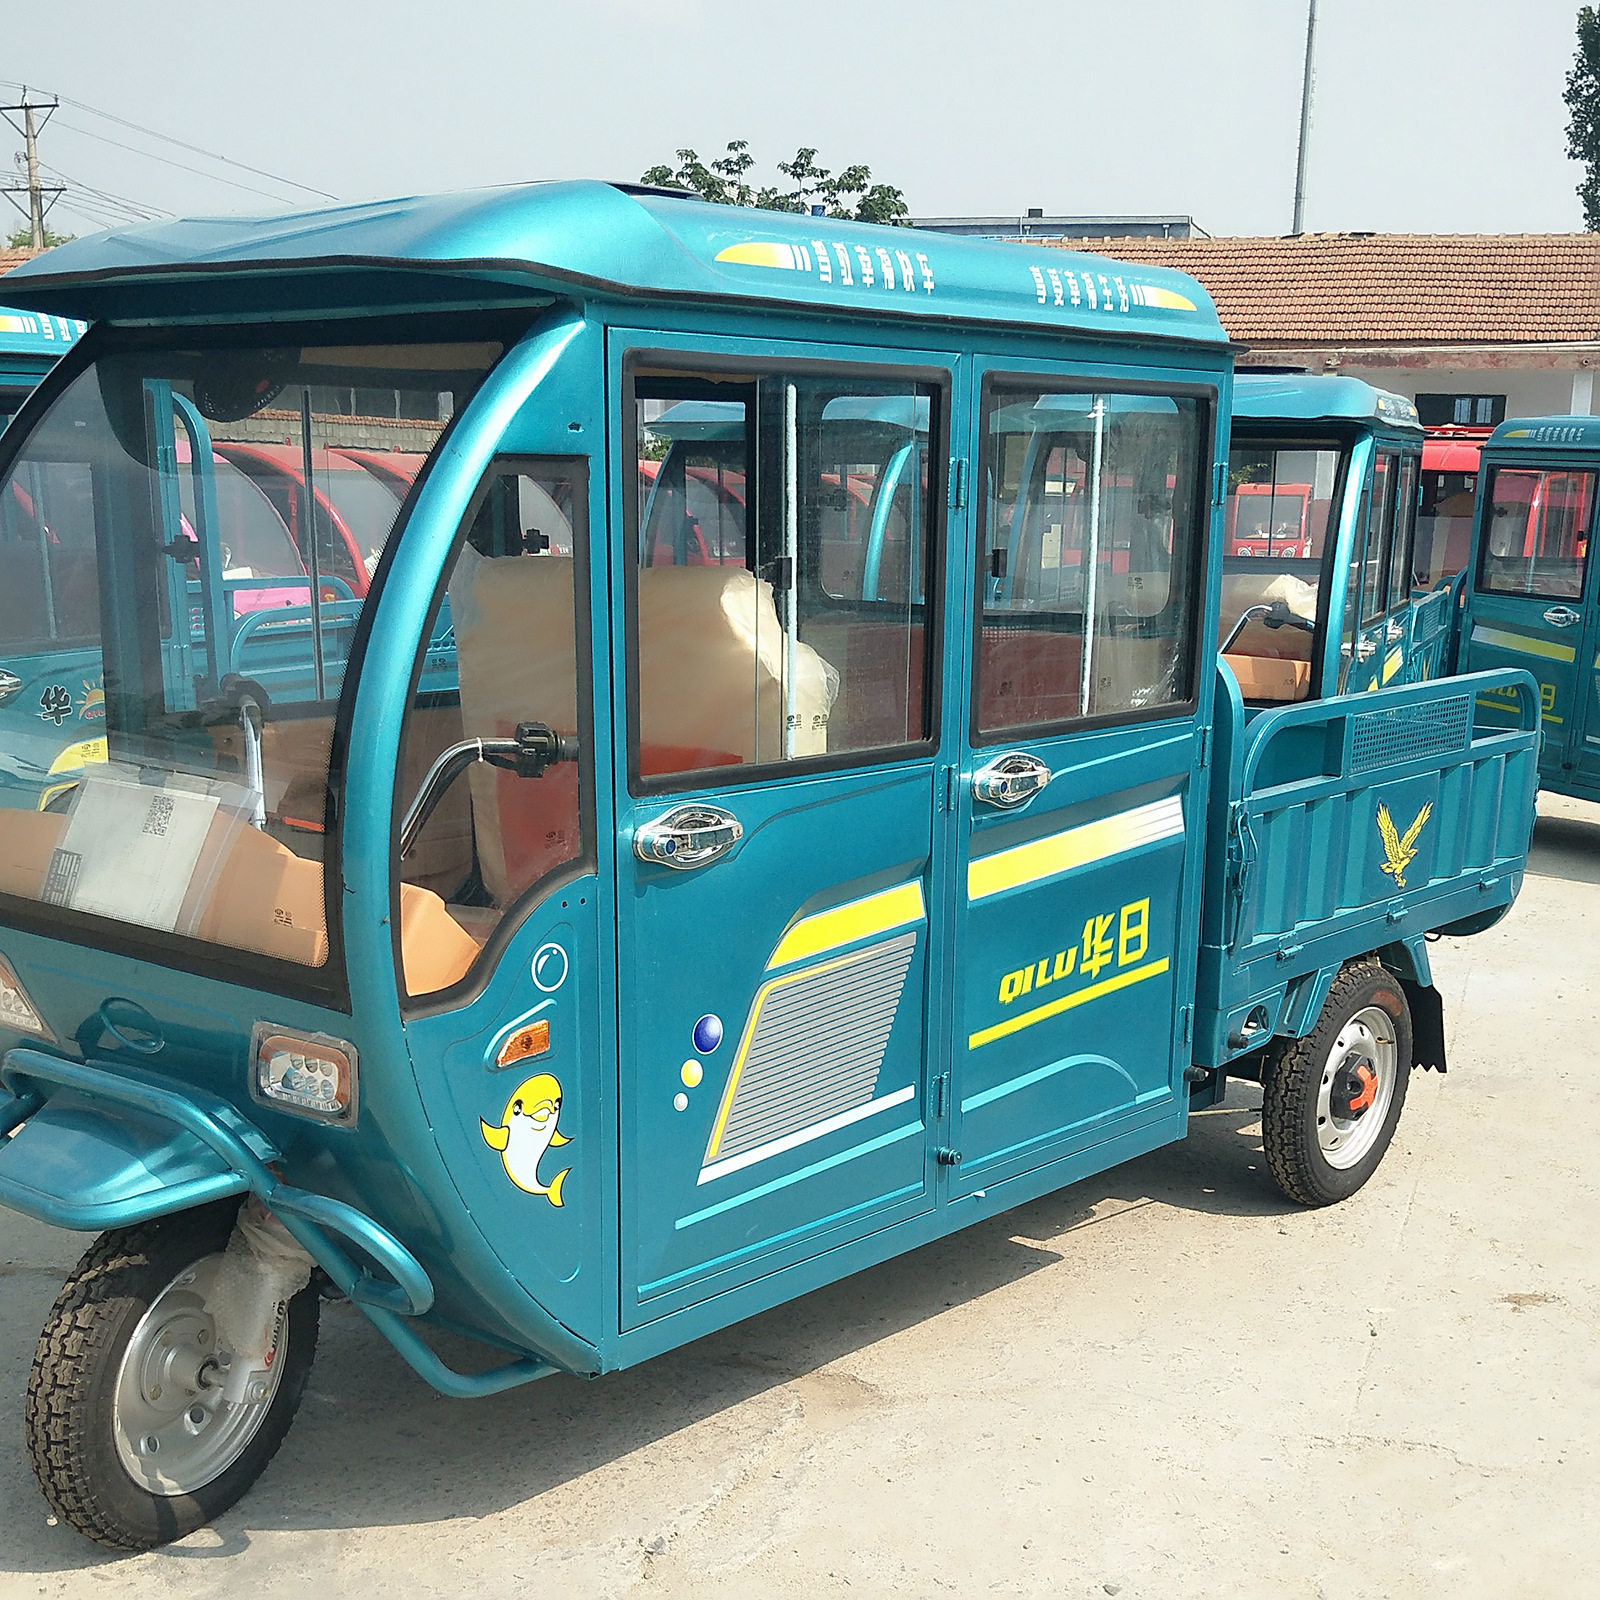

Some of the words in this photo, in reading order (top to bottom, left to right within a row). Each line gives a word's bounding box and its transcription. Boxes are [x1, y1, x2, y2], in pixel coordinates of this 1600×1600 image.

[1029, 266, 1129, 313] 享受幸福生活
